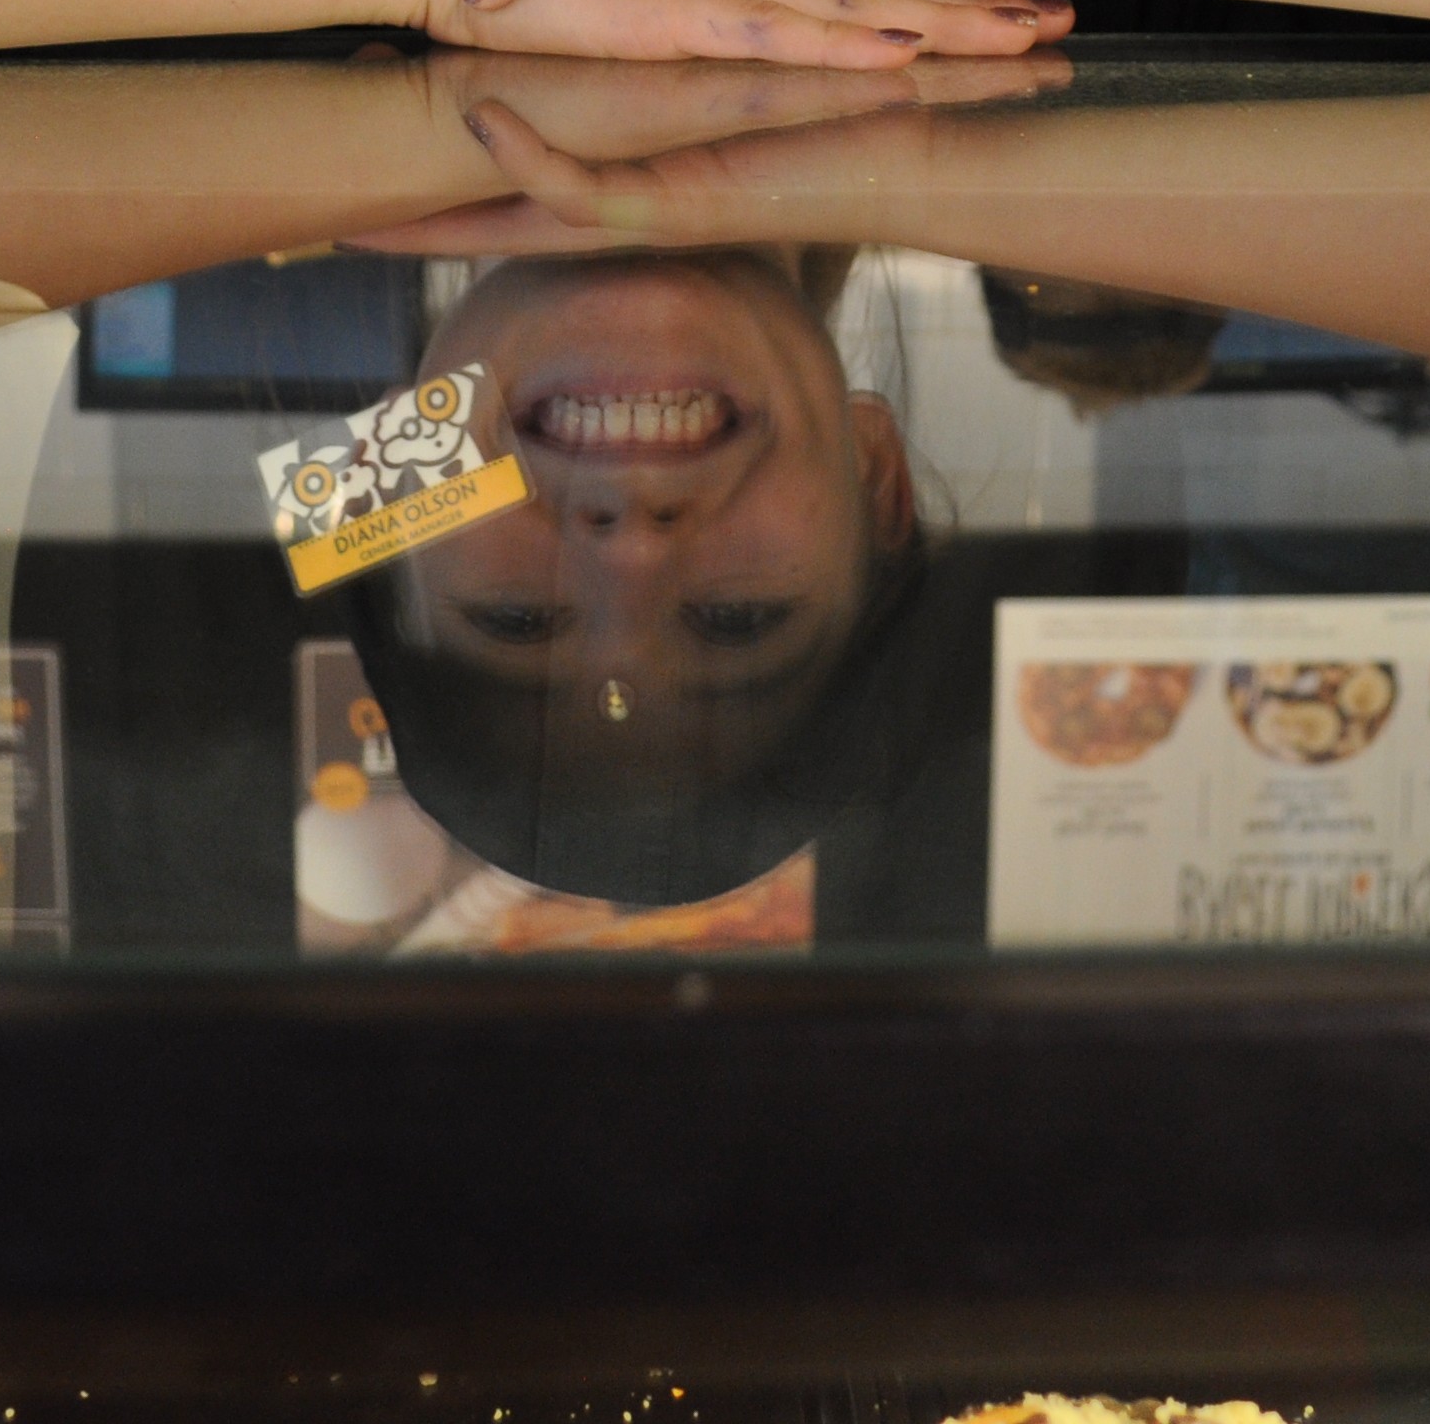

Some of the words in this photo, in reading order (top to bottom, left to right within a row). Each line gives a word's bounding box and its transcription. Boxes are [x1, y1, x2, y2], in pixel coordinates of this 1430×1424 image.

[334, 514, 400, 554] DIANA
[405, 479, 477, 522] OLSON
[361, 538, 407, 560] GENERAL
[410, 510, 464, 538] MANAGER
